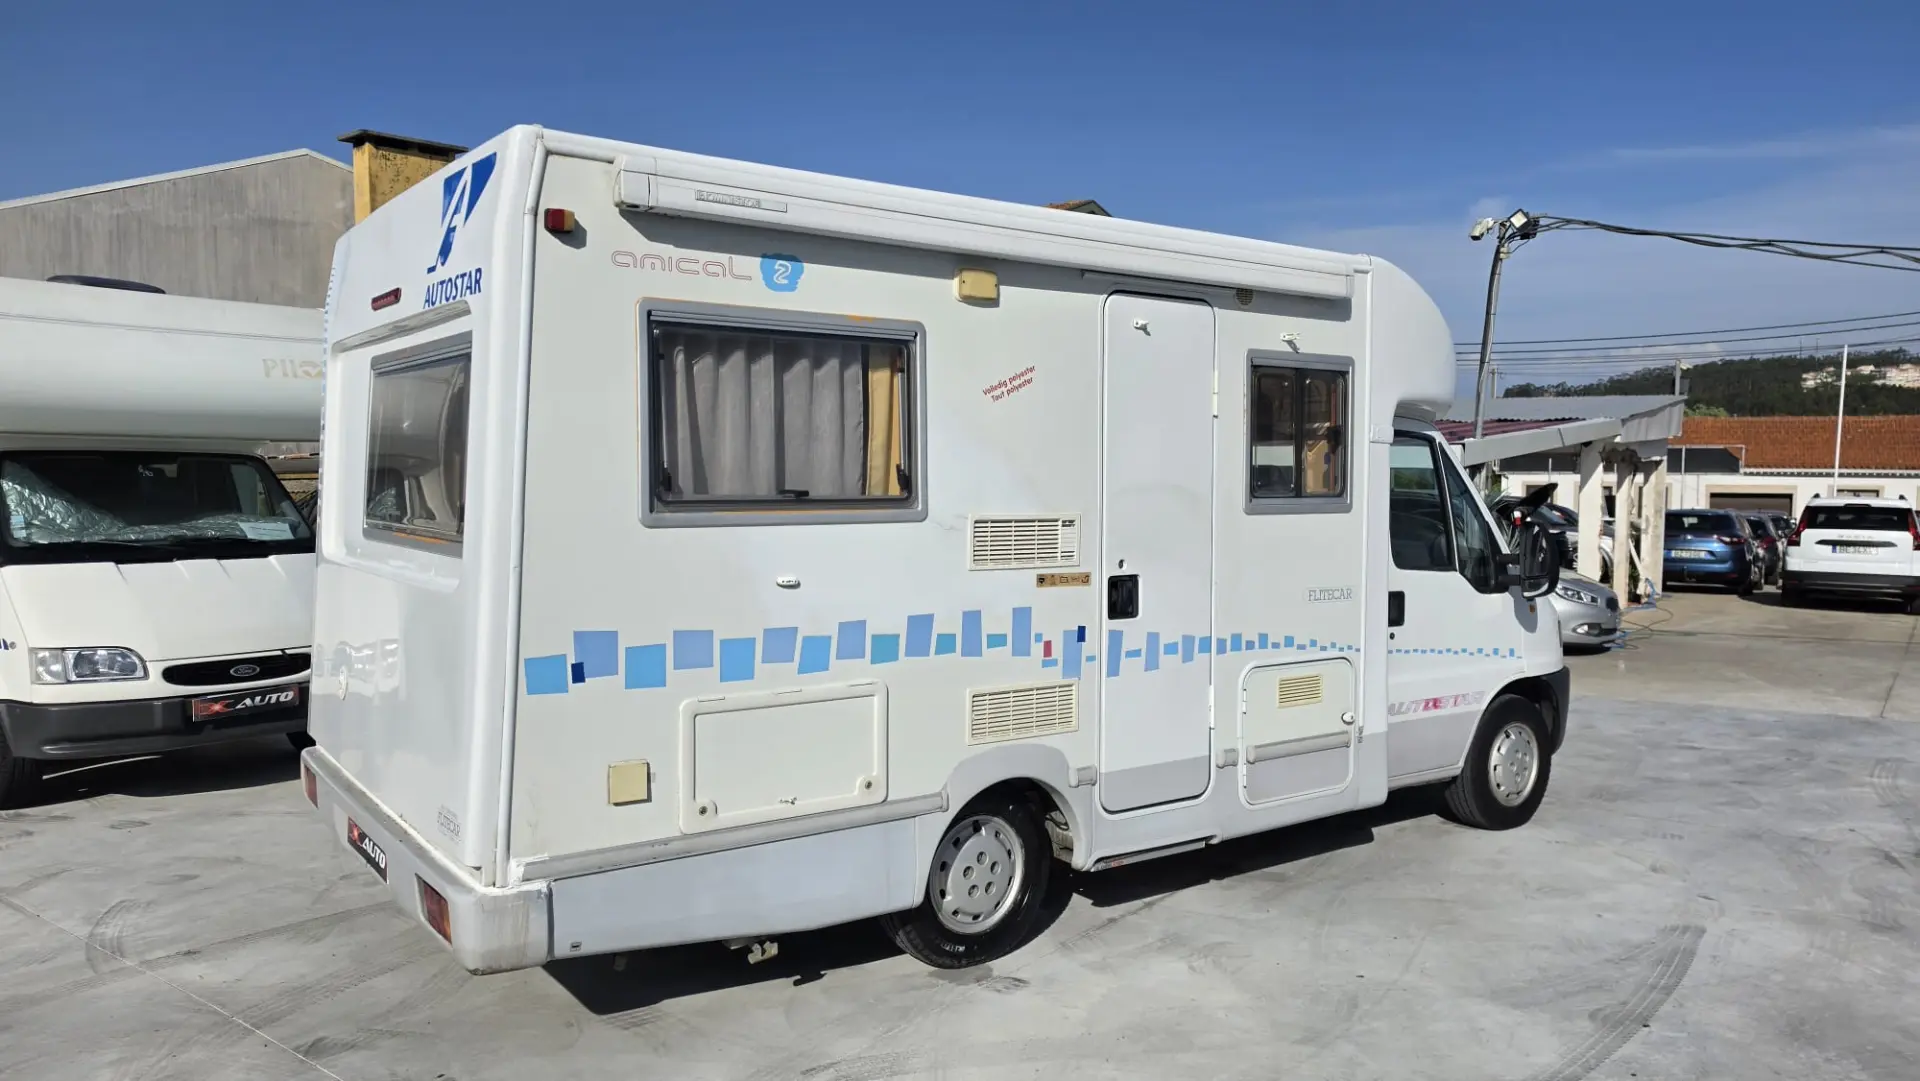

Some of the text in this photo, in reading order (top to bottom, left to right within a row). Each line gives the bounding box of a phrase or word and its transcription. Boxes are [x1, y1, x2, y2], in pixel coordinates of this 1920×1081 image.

[773, 261, 792, 284] 2
[423, 267, 482, 309] AUTOSTAR
[983, 365, 1035, 395] Volledig polyester
[991, 377, 1032, 402] Tout polyester
[1308, 588, 1352, 601] FLITECAR
[235, 691, 294, 709] AUTO
[362, 837, 386, 869] AUTO
